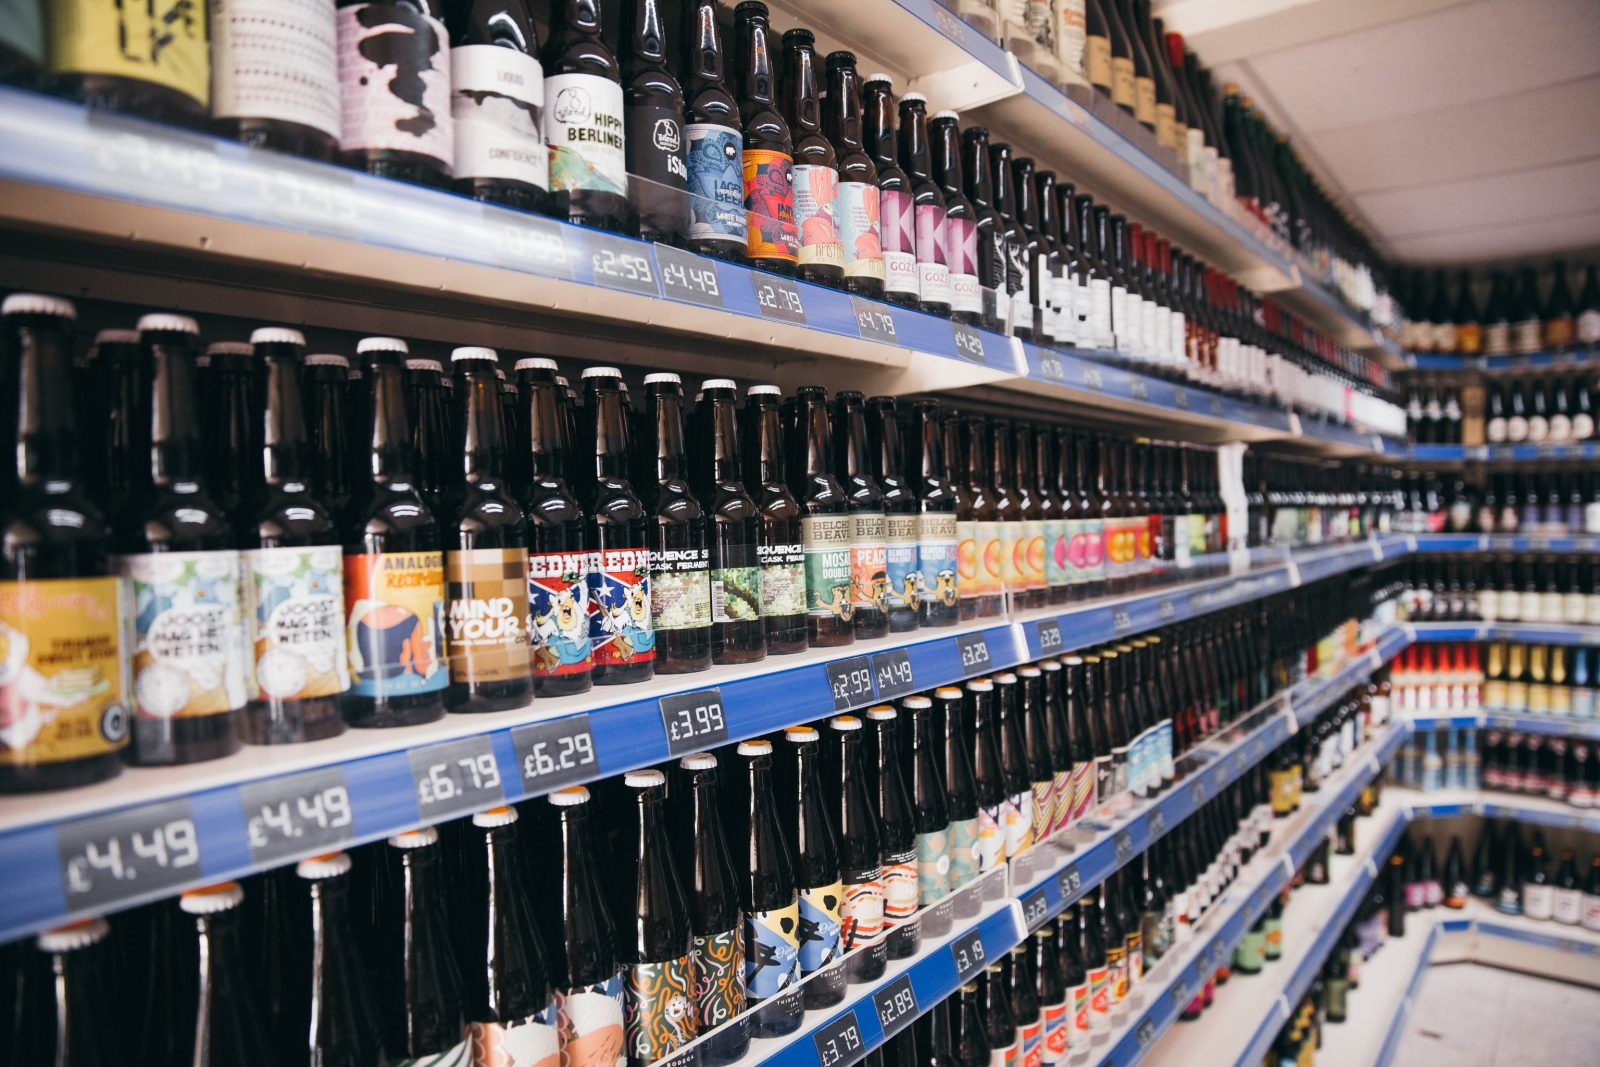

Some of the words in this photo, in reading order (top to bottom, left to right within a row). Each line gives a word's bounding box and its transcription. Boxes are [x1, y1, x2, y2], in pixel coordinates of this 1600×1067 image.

[593, 250, 652, 283] £2.59
[663, 263, 719, 297] £4.49
[758, 286, 804, 314] £2.79
[859, 310, 896, 336] £4.79
[954, 330, 985, 357] £4.29
[450, 597, 514, 620] MIND
[450, 616, 519, 640] YOUR
[962, 641, 989, 667] £3.29
[833, 667, 873, 700] £2.99
[877, 660, 913, 690] £4.49
[670, 703, 725, 742] £3.99
[523, 732, 595, 779] £6.29
[419, 753, 500, 805] £6.79
[248, 785, 352, 849] £4.49
[67, 819, 199, 894] £4.49
[957, 939, 985, 973] £3.19
[881, 987, 914, 1027] £2.89
[822, 1024, 861, 1066] £3.79
